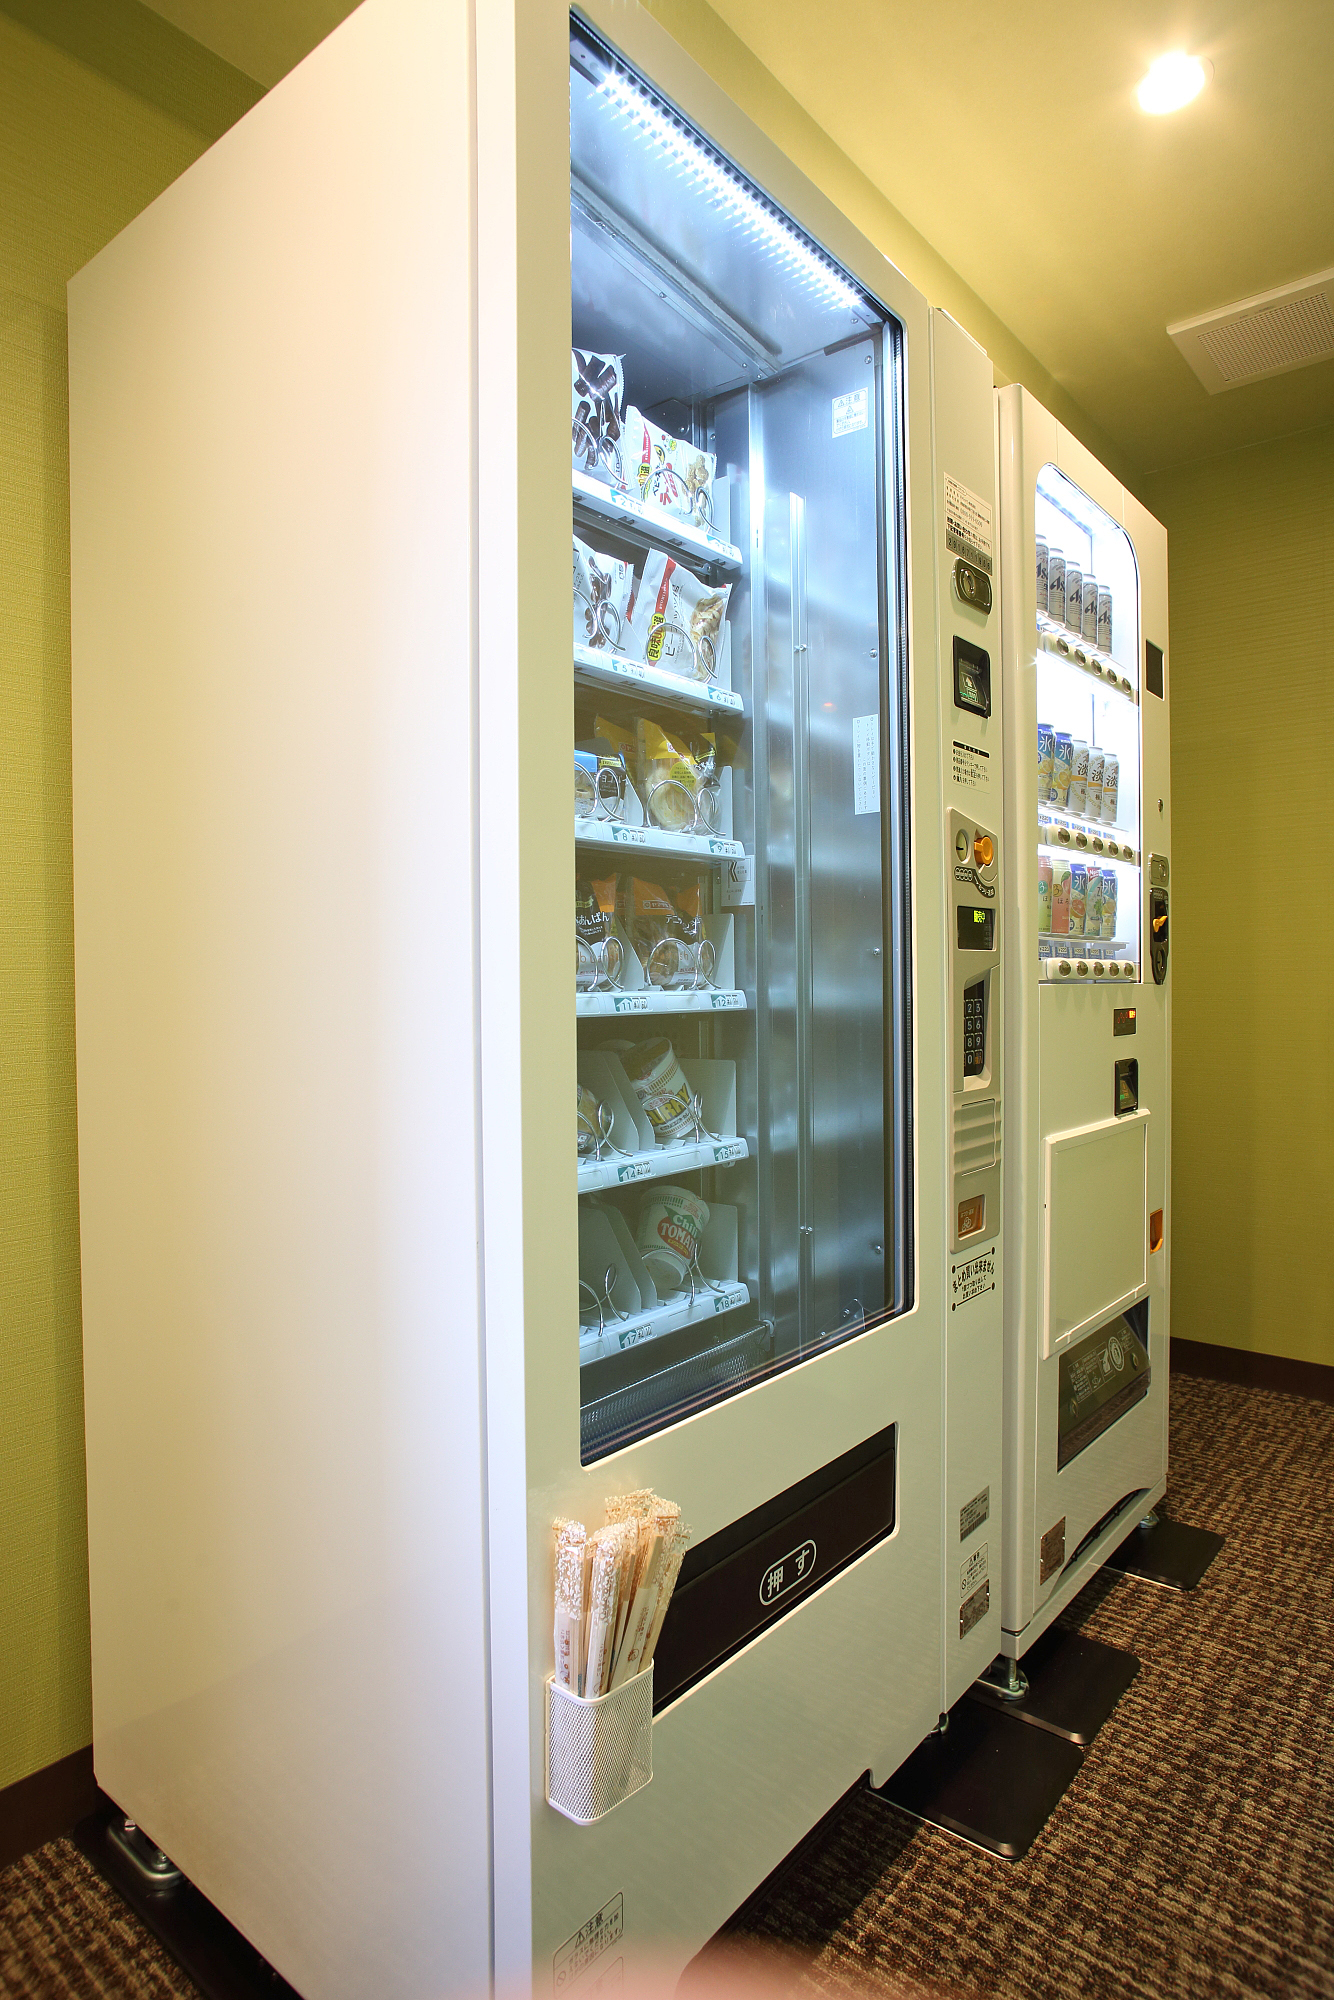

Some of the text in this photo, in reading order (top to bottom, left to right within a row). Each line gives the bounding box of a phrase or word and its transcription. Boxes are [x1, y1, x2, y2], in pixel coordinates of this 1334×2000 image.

[622, 832, 628, 841] 8
[717, 845, 722, 853] 9
[622, 1001, 632, 1010] 11
[717, 998, 727, 1006] 12
[968, 1003, 980, 1013] 2 3
[968, 1020, 980, 1030] 5 6
[968, 1037, 980, 1047] 8 9
[968, 1055, 972, 1064] 0
[720, 1150, 729, 1159] 15
[625, 1170, 636, 1179] 14
[673, 1215, 697, 1238] Chili
[720, 1300, 729, 1309] 18
[627, 1334, 637, 1344] 17
[768, 1549, 810, 1598] 押す
